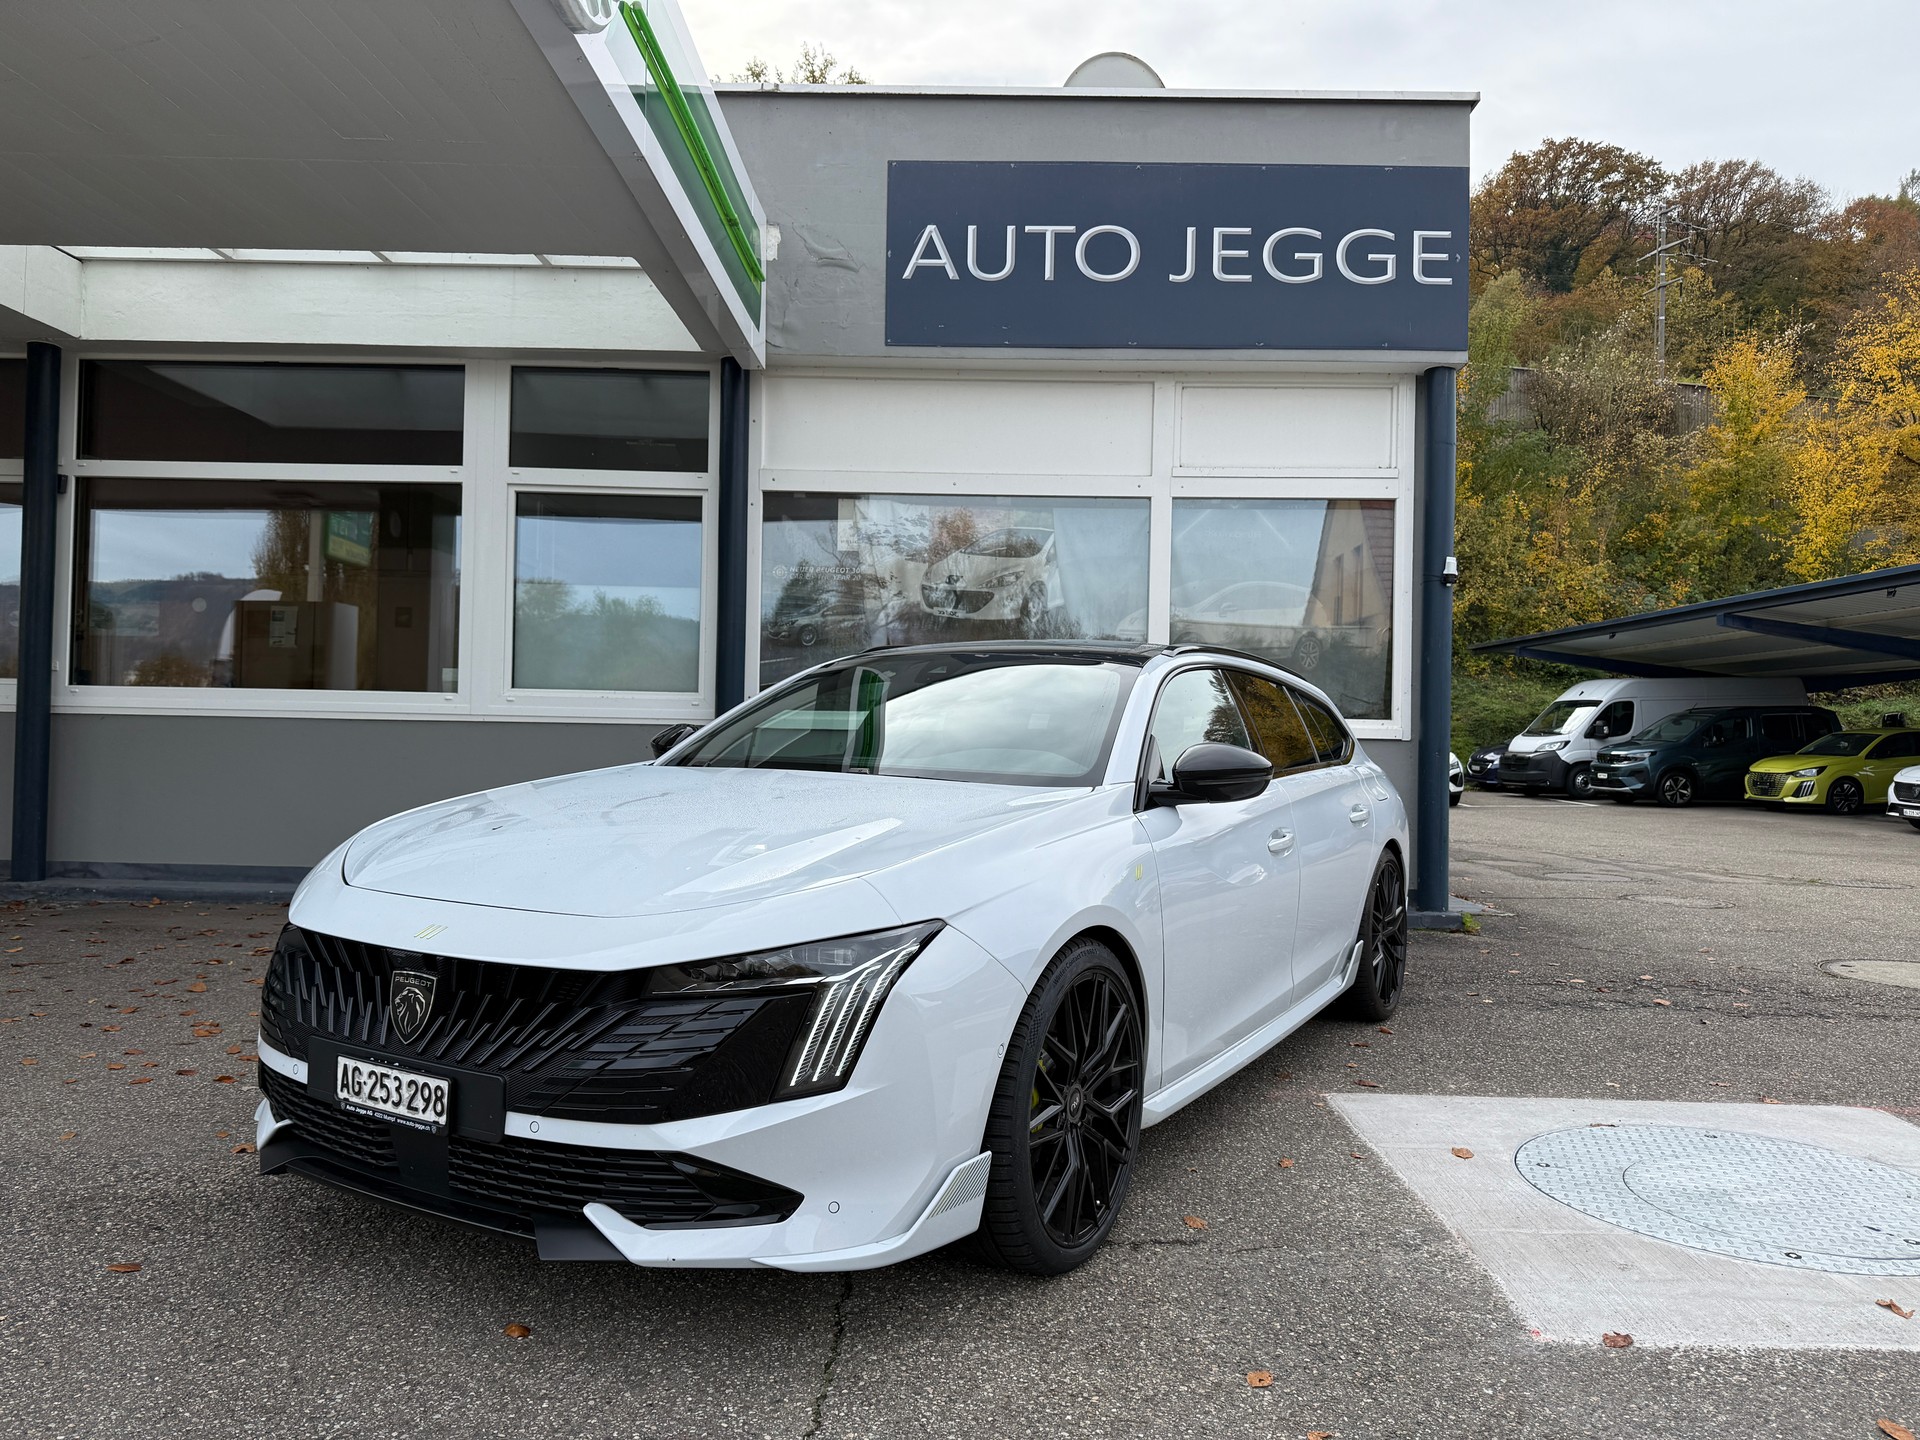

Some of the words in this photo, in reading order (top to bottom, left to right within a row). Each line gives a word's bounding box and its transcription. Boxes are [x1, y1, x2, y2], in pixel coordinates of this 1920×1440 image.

[902, 224, 1141, 282] AUTO
[1168, 226, 1453, 285] JEGGE
[395, 976, 432, 987] PEUGEOT
